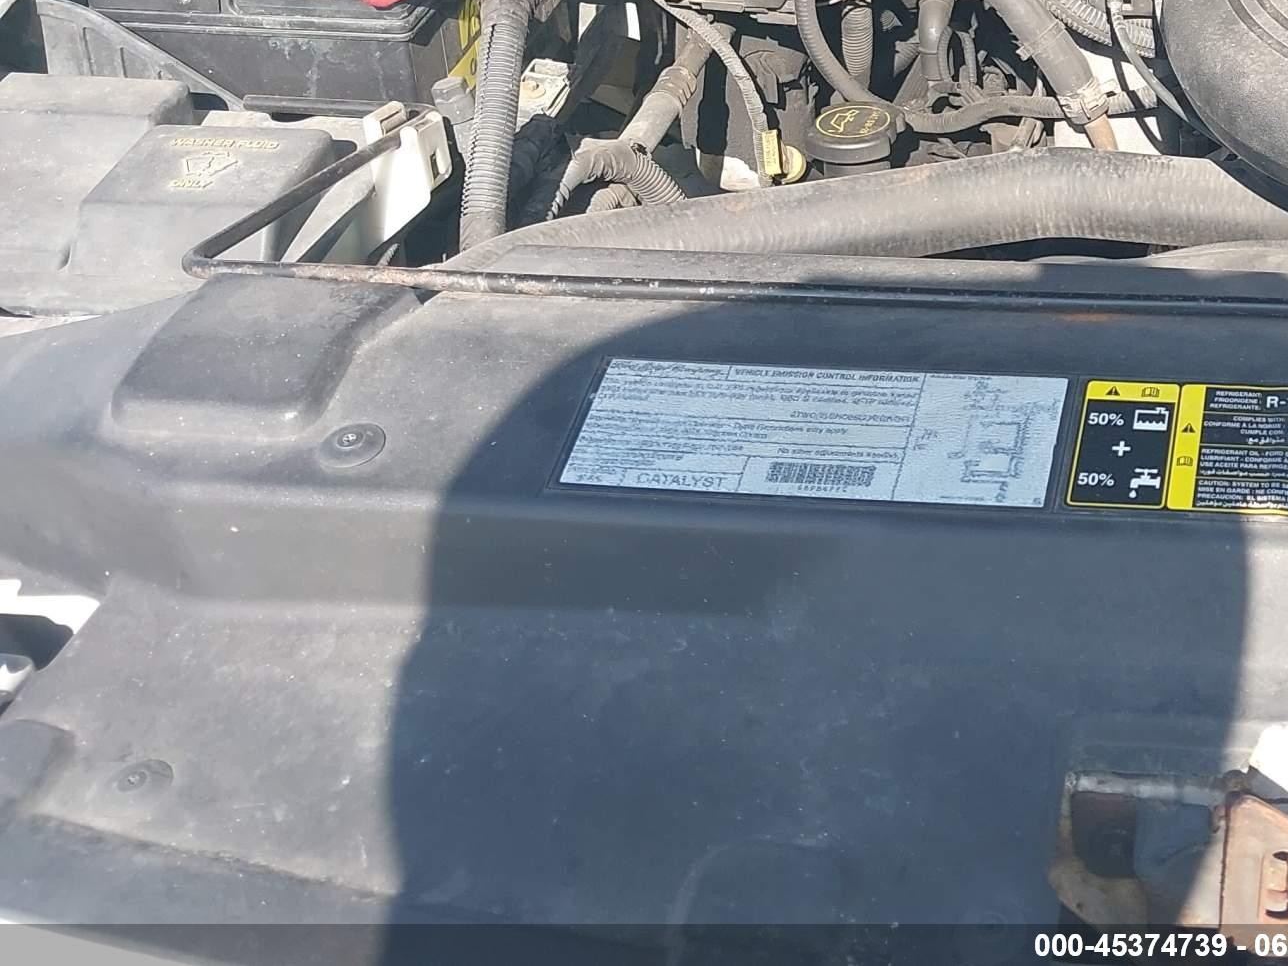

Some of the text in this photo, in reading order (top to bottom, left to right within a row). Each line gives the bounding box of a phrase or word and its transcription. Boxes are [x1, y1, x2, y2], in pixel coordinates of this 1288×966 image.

[238, 139, 280, 149] FLUID
[771, 370, 814, 379] EMISSION
[816, 372, 857, 381] CONTROL
[858, 374, 921, 383] INFORMATION
[1215, 390, 1262, 398] REFRIGERANT:
[1087, 412, 1125, 426] 50%
[1201, 448, 1248, 456] REFRIGERANT
[637, 473, 729, 489] CATALYST
[1077, 472, 1115, 487] 50%
